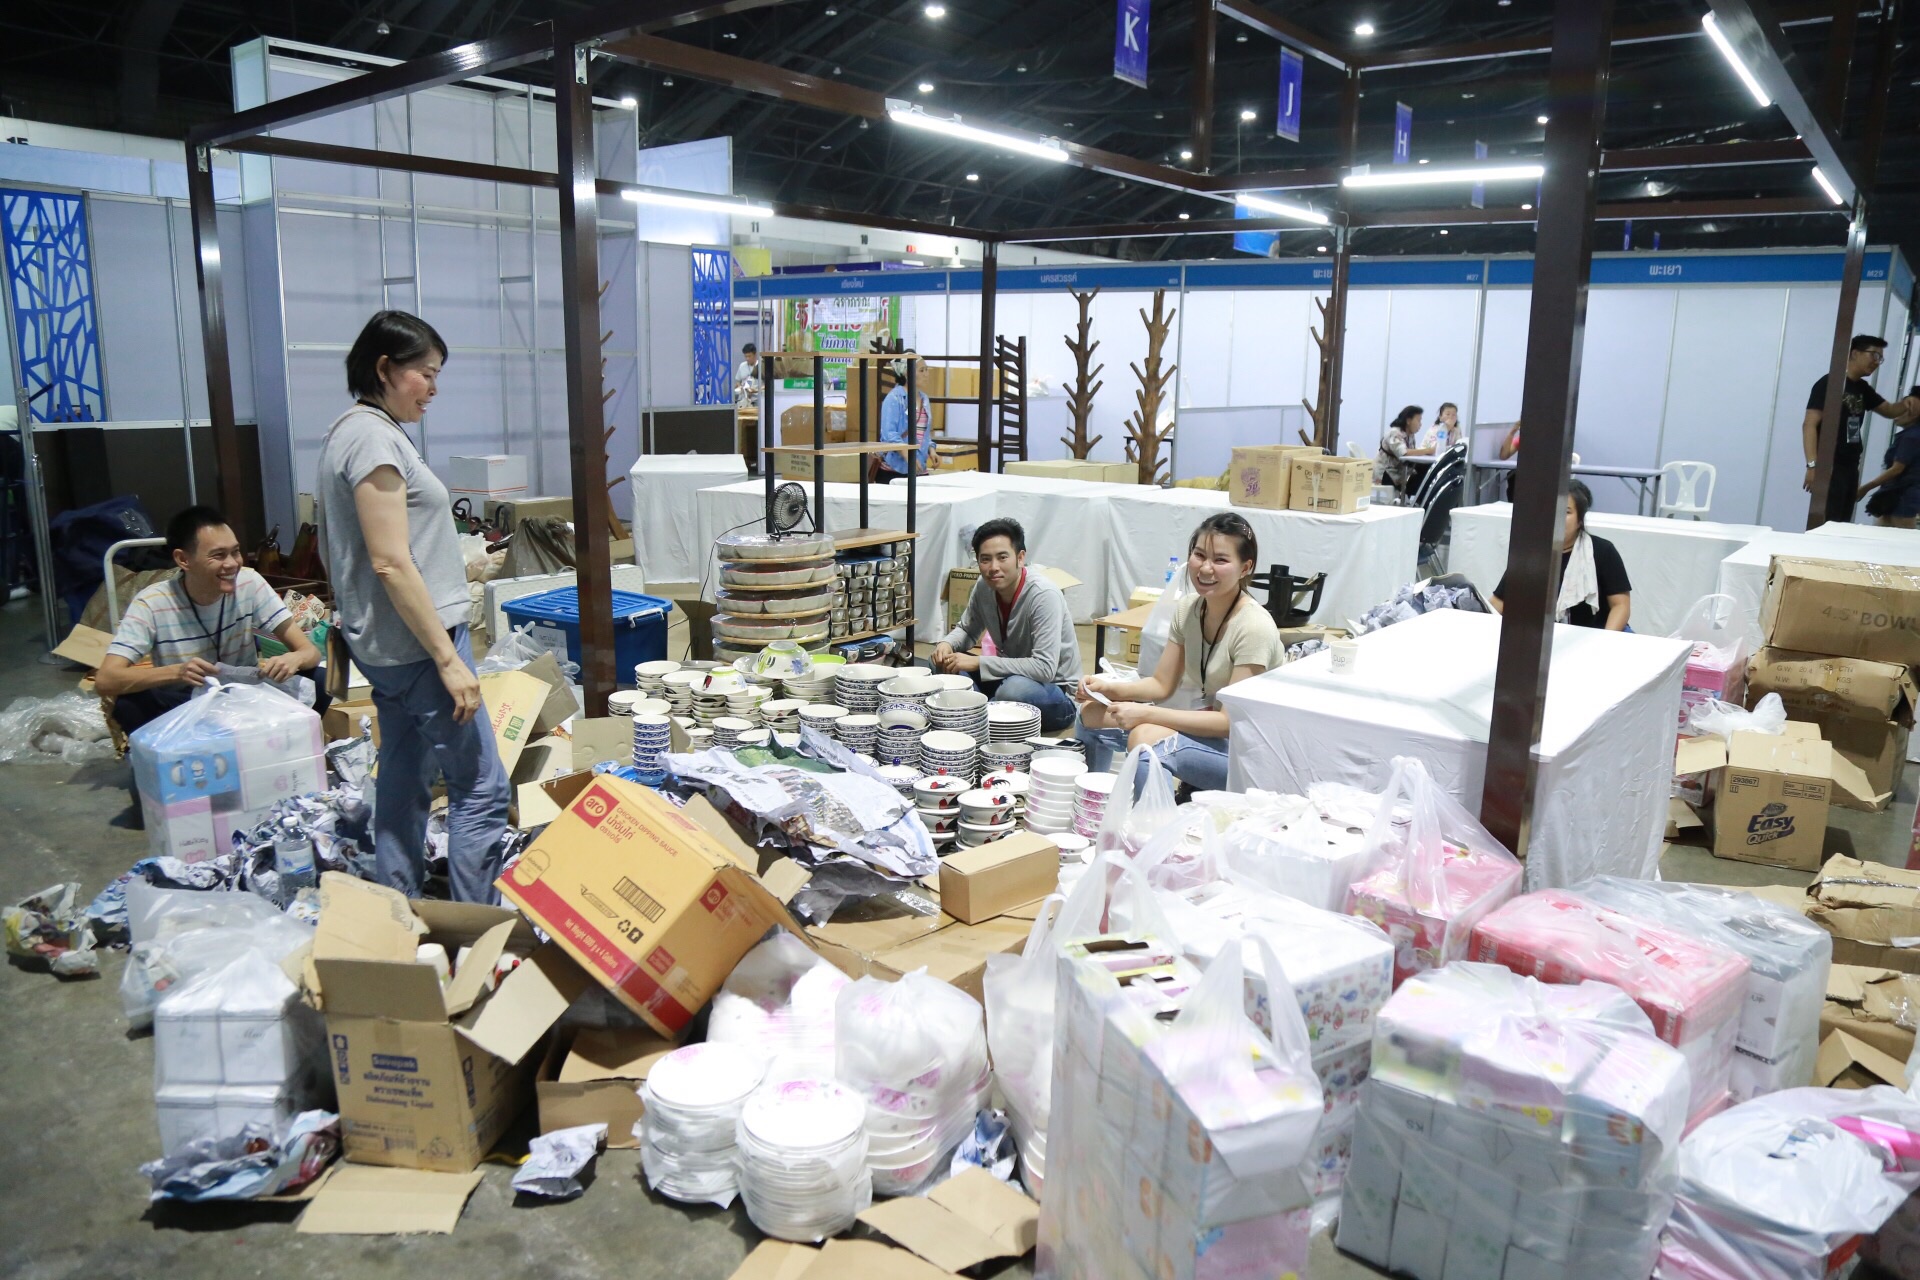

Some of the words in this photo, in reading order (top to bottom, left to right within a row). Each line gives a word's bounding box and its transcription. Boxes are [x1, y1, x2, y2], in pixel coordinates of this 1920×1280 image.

[1124, 12, 1140, 52] K
[1286, 82, 1294, 117] J
[1398, 130, 1408, 157] H
[751, 222, 760, 233] 11
[860, 234, 869, 245] 10
[1313, 269, 1333, 278] พะเย
[1649, 265, 1682, 276] พะเยา
[1867, 270, 1884, 278] M29
[841, 278, 864, 289] เชียงใหม่
[1041, 272, 1077, 283] นครสวรรค์
[585, 797, 606, 815] aro
[1747, 815, 1795, 833] Easy
[617, 807, 639, 828] CHICKEN
[639, 824, 660, 843] DIPPING
[660, 840, 679, 858] SAUCE
[1747, 831, 1779, 845] Quick
